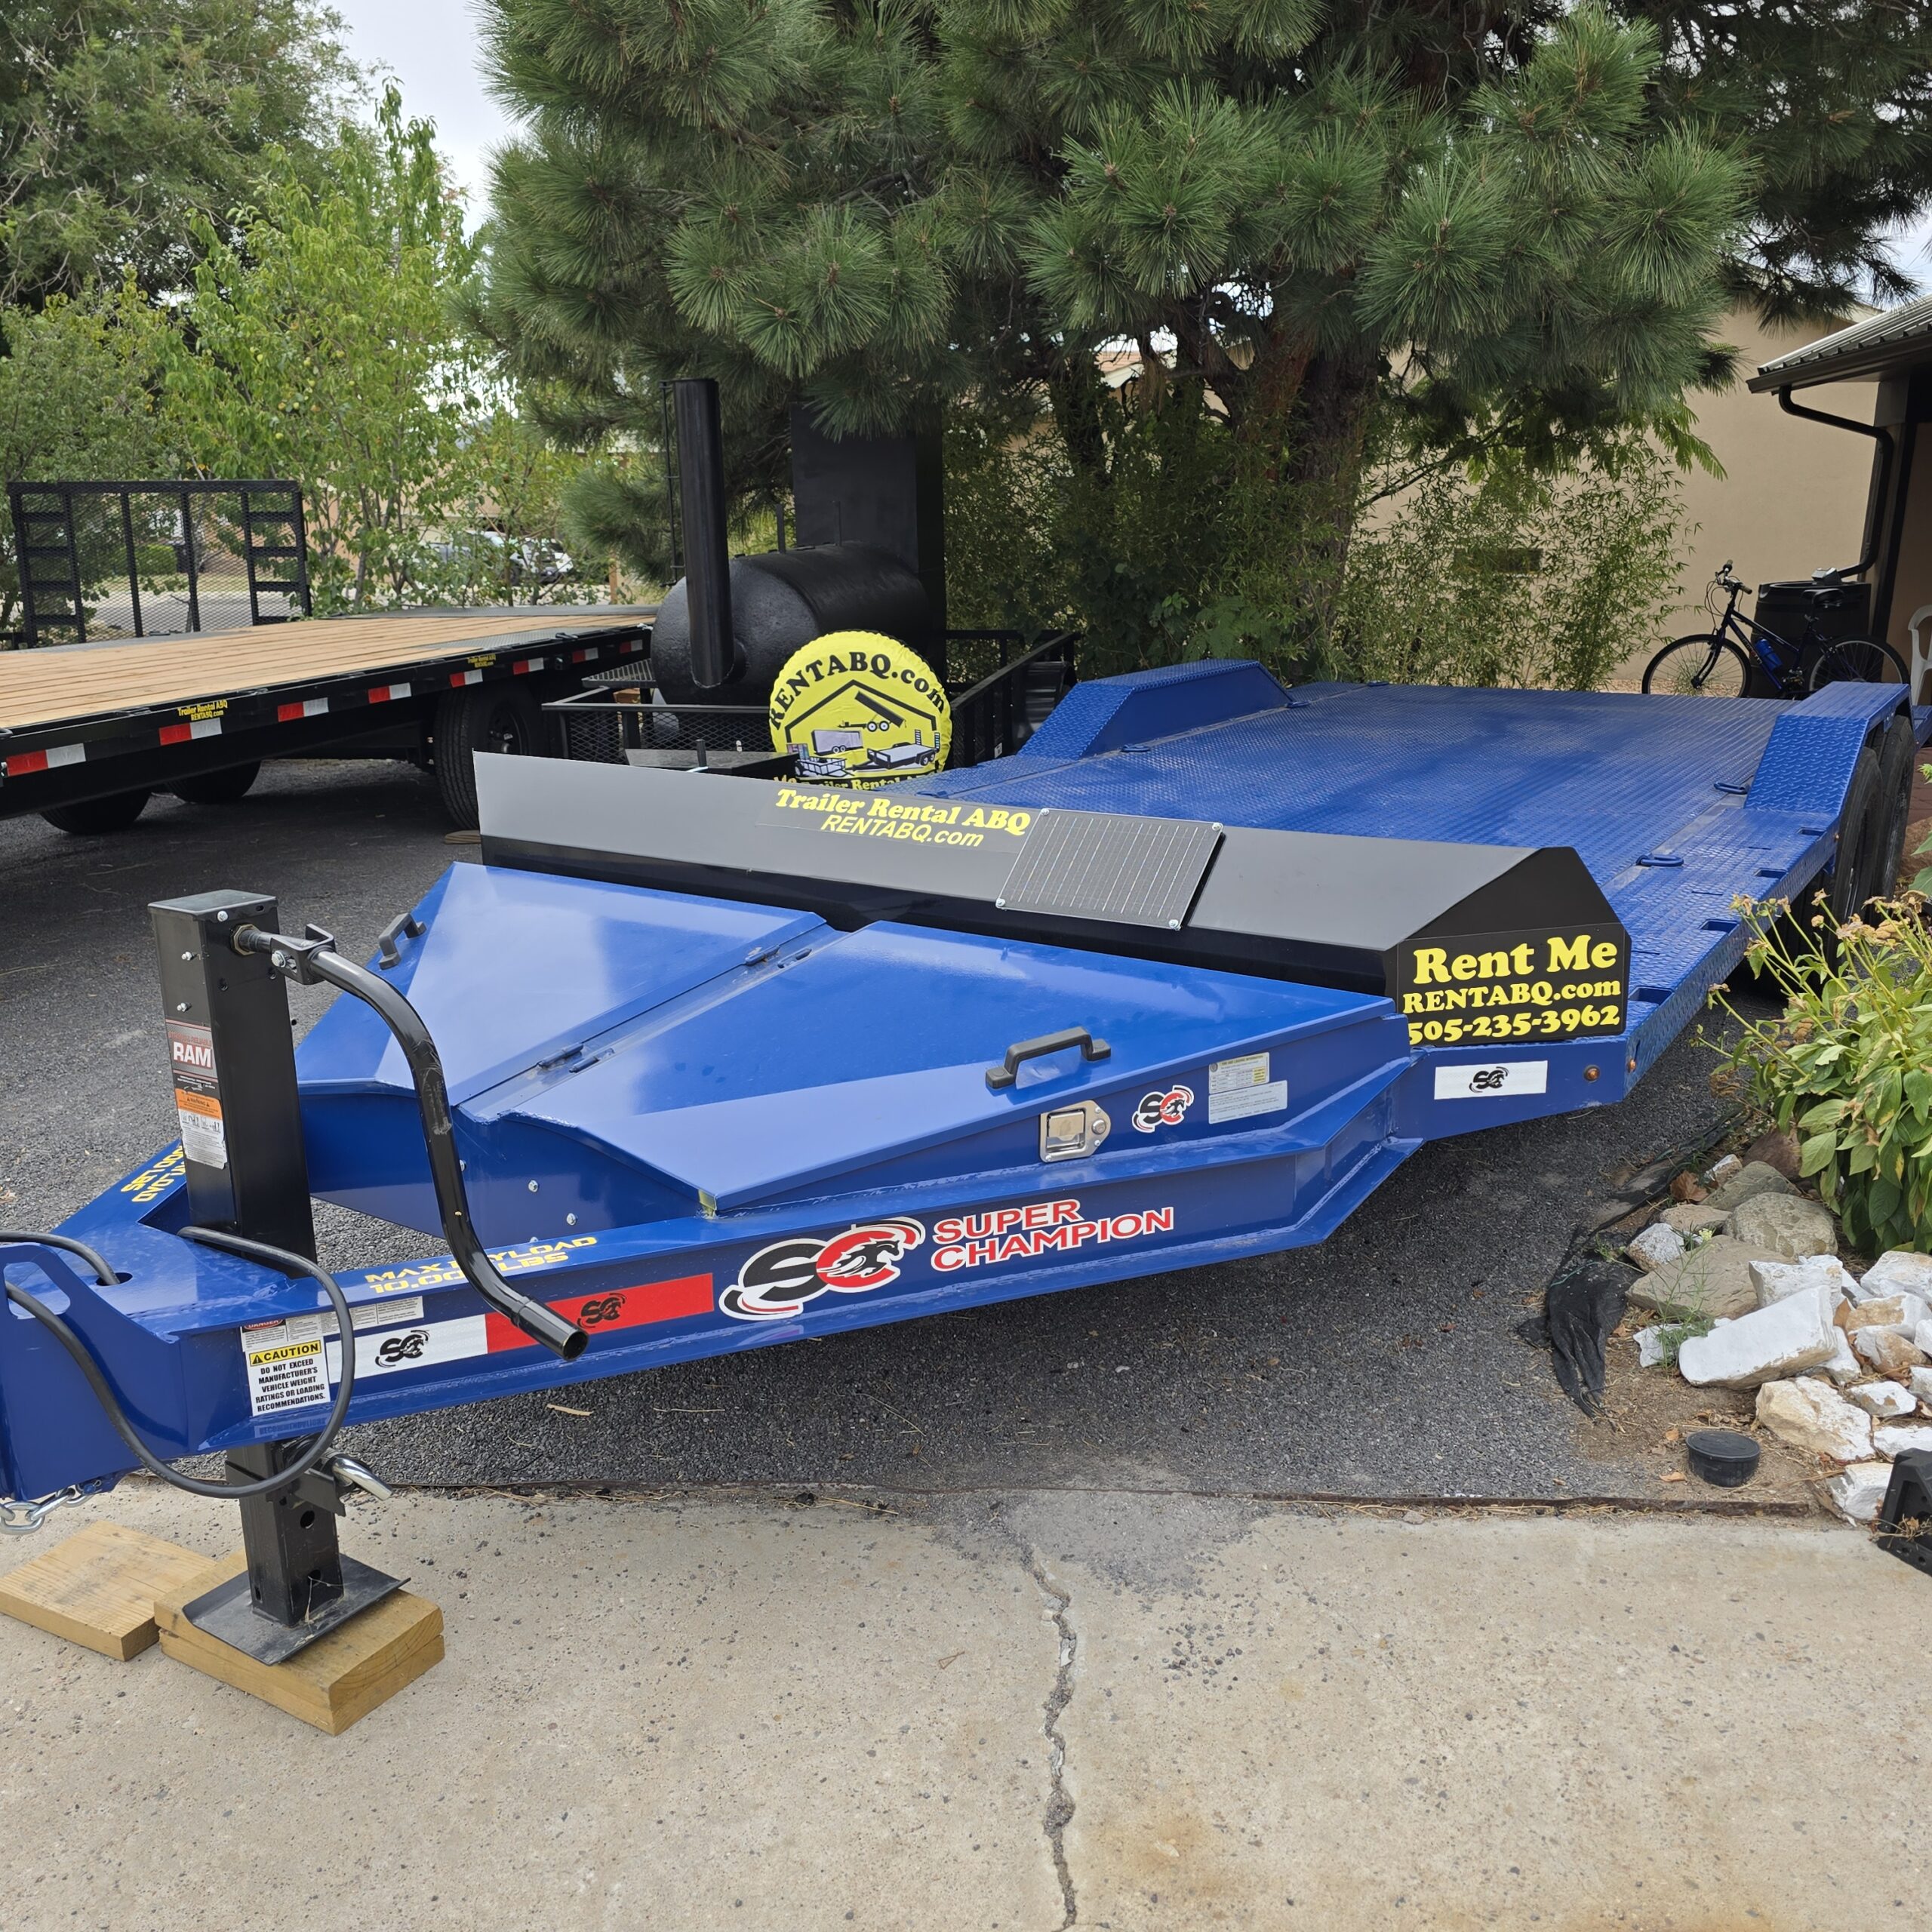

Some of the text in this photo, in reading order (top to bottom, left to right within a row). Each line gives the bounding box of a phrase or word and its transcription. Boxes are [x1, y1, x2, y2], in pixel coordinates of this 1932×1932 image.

[768, 651, 946, 730] RENTABQ.com
[177, 706, 196, 716] Trailer
[196, 702, 216, 712] Rental
[776, 789, 1031, 835] Trailer Rental ABQ
[820, 814, 984, 847] RENTABQ.com
[1413, 934, 1617, 984] Rent Me
[1402, 980, 1621, 1014] RENTABQ.com
[1408, 1004, 1620, 1045] 505-235-3962
[173, 1041, 212, 1068] RAM
[933, 1198, 1084, 1244] SUPER
[931, 1207, 1174, 1272] CHAMPION
[365, 1236, 598, 1283] MAX YLOAD
[370, 1251, 569, 1294] 10.00 LBS
[260, 1358, 314, 1375] DO NOT EXCEED
[263, 1343, 318, 1361] CAUTION
[258, 1367, 318, 1384] MANUFACTURER'S
[262, 1376, 317, 1392] VEHICLE WEIGHT
[255, 1392, 285, 1404] RATINGS
[296, 1383, 325, 1395] LOADING
[257, 1392, 325, 1412] RECOMMENDATIONS.
